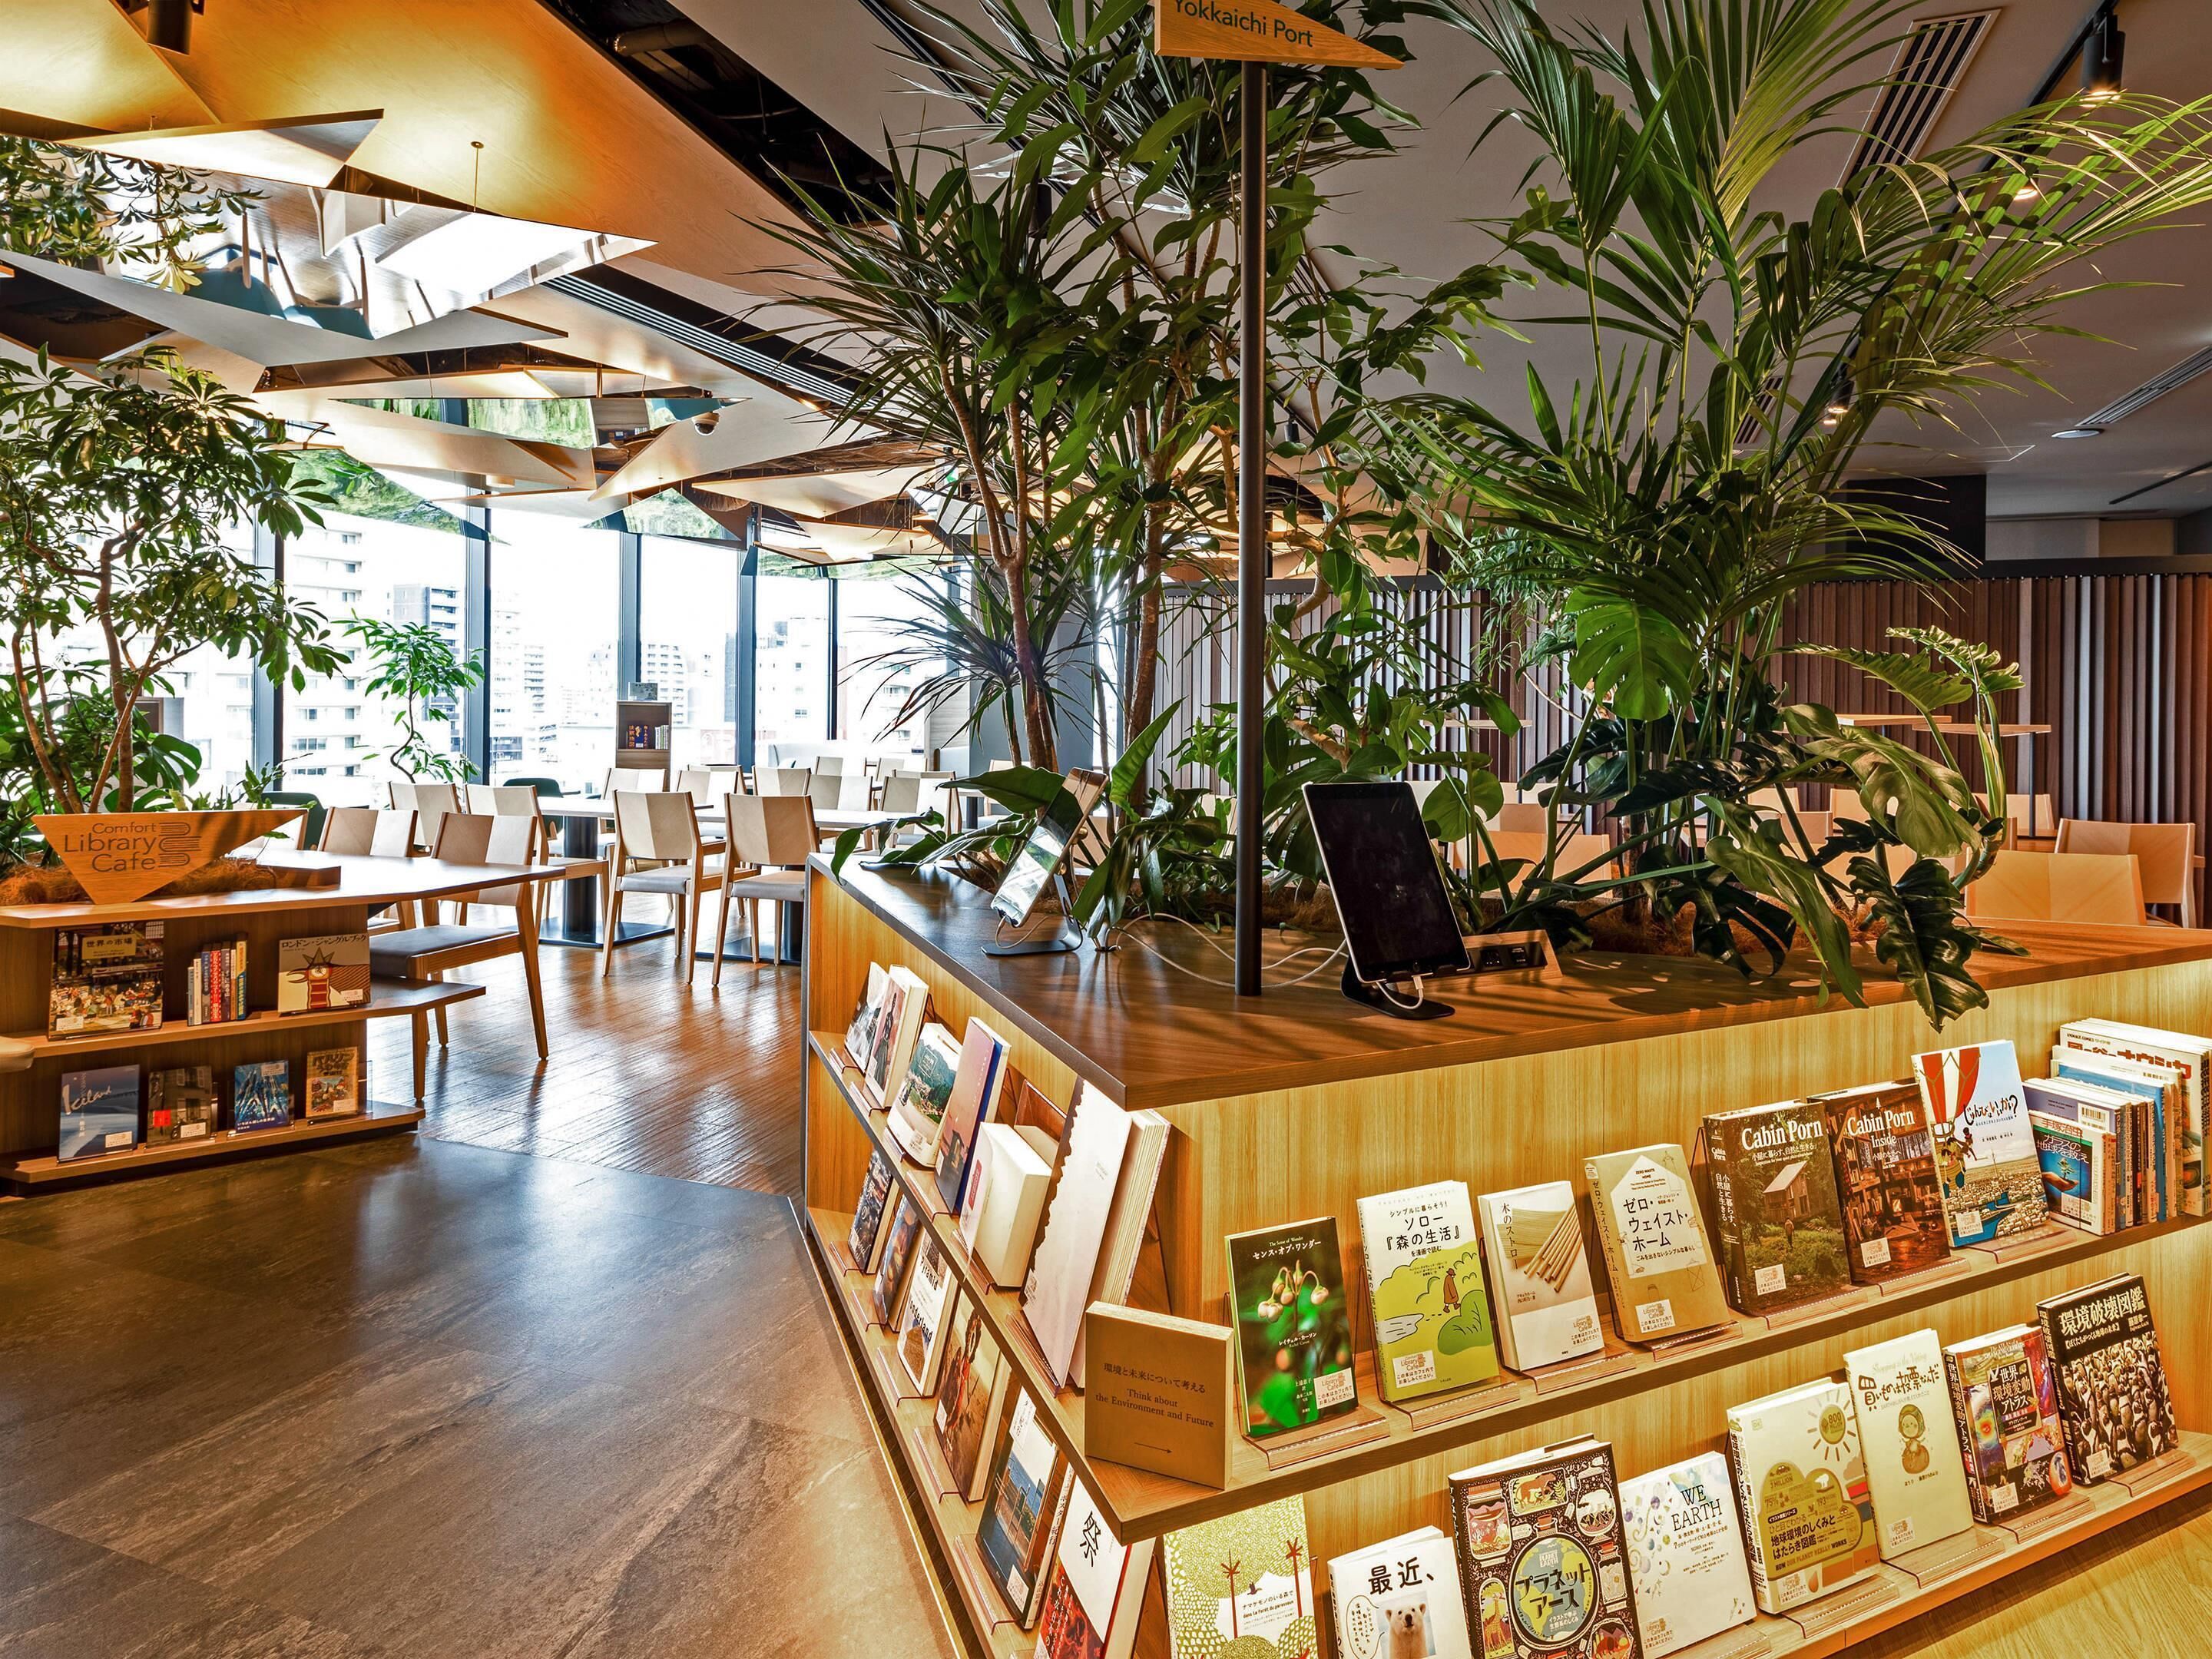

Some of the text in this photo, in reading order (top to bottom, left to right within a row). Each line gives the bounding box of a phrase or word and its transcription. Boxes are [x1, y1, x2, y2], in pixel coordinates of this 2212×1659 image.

[1175, 0, 1313, 48] Yokkaichi Port
[91, 821, 157, 834] Comfort
[64, 833, 157, 855] Library
[91, 852, 156, 873] Cafe
[85, 937, 133, 949] 世界の市場
[281, 934, 367, 949] ロンドン・ジャングルブック
[1847, 1110, 1916, 1136] Cabin Porn
[2041, 1118, 2084, 1138] 手塚治虫
[1741, 1120, 1824, 1151] Cabin Porn
[1871, 1132, 1897, 1148] Inside
[2043, 1134, 2081, 1152] ガラスの
[1711, 1147, 1727, 1156] Cabin
[1714, 1152, 1727, 1161] Porn
[2037, 1140, 2090, 1164] 地球を救え
[1623, 1198, 1654, 1214] ゼロ・
[1715, 1173, 1727, 1221] 自然と生きる
[1722, 1174, 1737, 1227] 小屋に暮らす、
[1404, 1215, 1444, 1231] ソロー
[1592, 1181, 1618, 1272] ゼロ・ウェイスト・ホーム
[1628, 1209, 1688, 1233] ウェイスト・
[1386, 1225, 1460, 1251] 『森の生活』
[1502, 1202, 1519, 1270] 木のストロー
[1632, 1231, 1671, 1252] ホーム
[1253, 1239, 1322, 1260] センス・オブ・ワンダー
[1410, 1245, 1442, 1257] を漫画で読む
[909, 1295, 933, 1343] onderland
[2058, 1285, 2146, 1336] 環境破壊図鑑
[1278, 1332, 1317, 1346] レイチェル・カーソン
[1103, 1363, 1206, 1393] 環境と未来について考える
[1396, 1367, 1435, 1380] この本はカフェ内で
[1399, 1373, 1435, 1385] お楽しみください。
[1999, 1364, 2018, 1383] 世界
[1127, 1389, 1178, 1407] Think about
[1992, 1376, 2031, 1401] 環境変動
[1095, 1393, 1214, 1428] the Environment and Future
[1948, 1363, 1972, 1453] 世界環境変動アトラス
[2001, 1395, 2028, 1415] アトラス
[1828, 1412, 1842, 1424] 800
[1773, 1475, 1793, 1488] MILLION
[1680, 1484, 1707, 1505] WE
[1671, 1498, 1723, 1532] EARTH
[1769, 1514, 1807, 1534] ひと目でわかる
[1770, 1514, 1836, 1547] 地球環境のしくみと
[1773, 1534, 1817, 1560] はたらき図鑑
[1775, 1562, 1786, 1571] HOW
[1831, 1538, 1848, 1550] WORKS
[1367, 1556, 1435, 1595] 最近、
[1515, 1562, 1591, 1602] プラネット
[1242, 1590, 1293, 1611] ナマケモノのいる森で
[1529, 1588, 1580, 1620] アース
